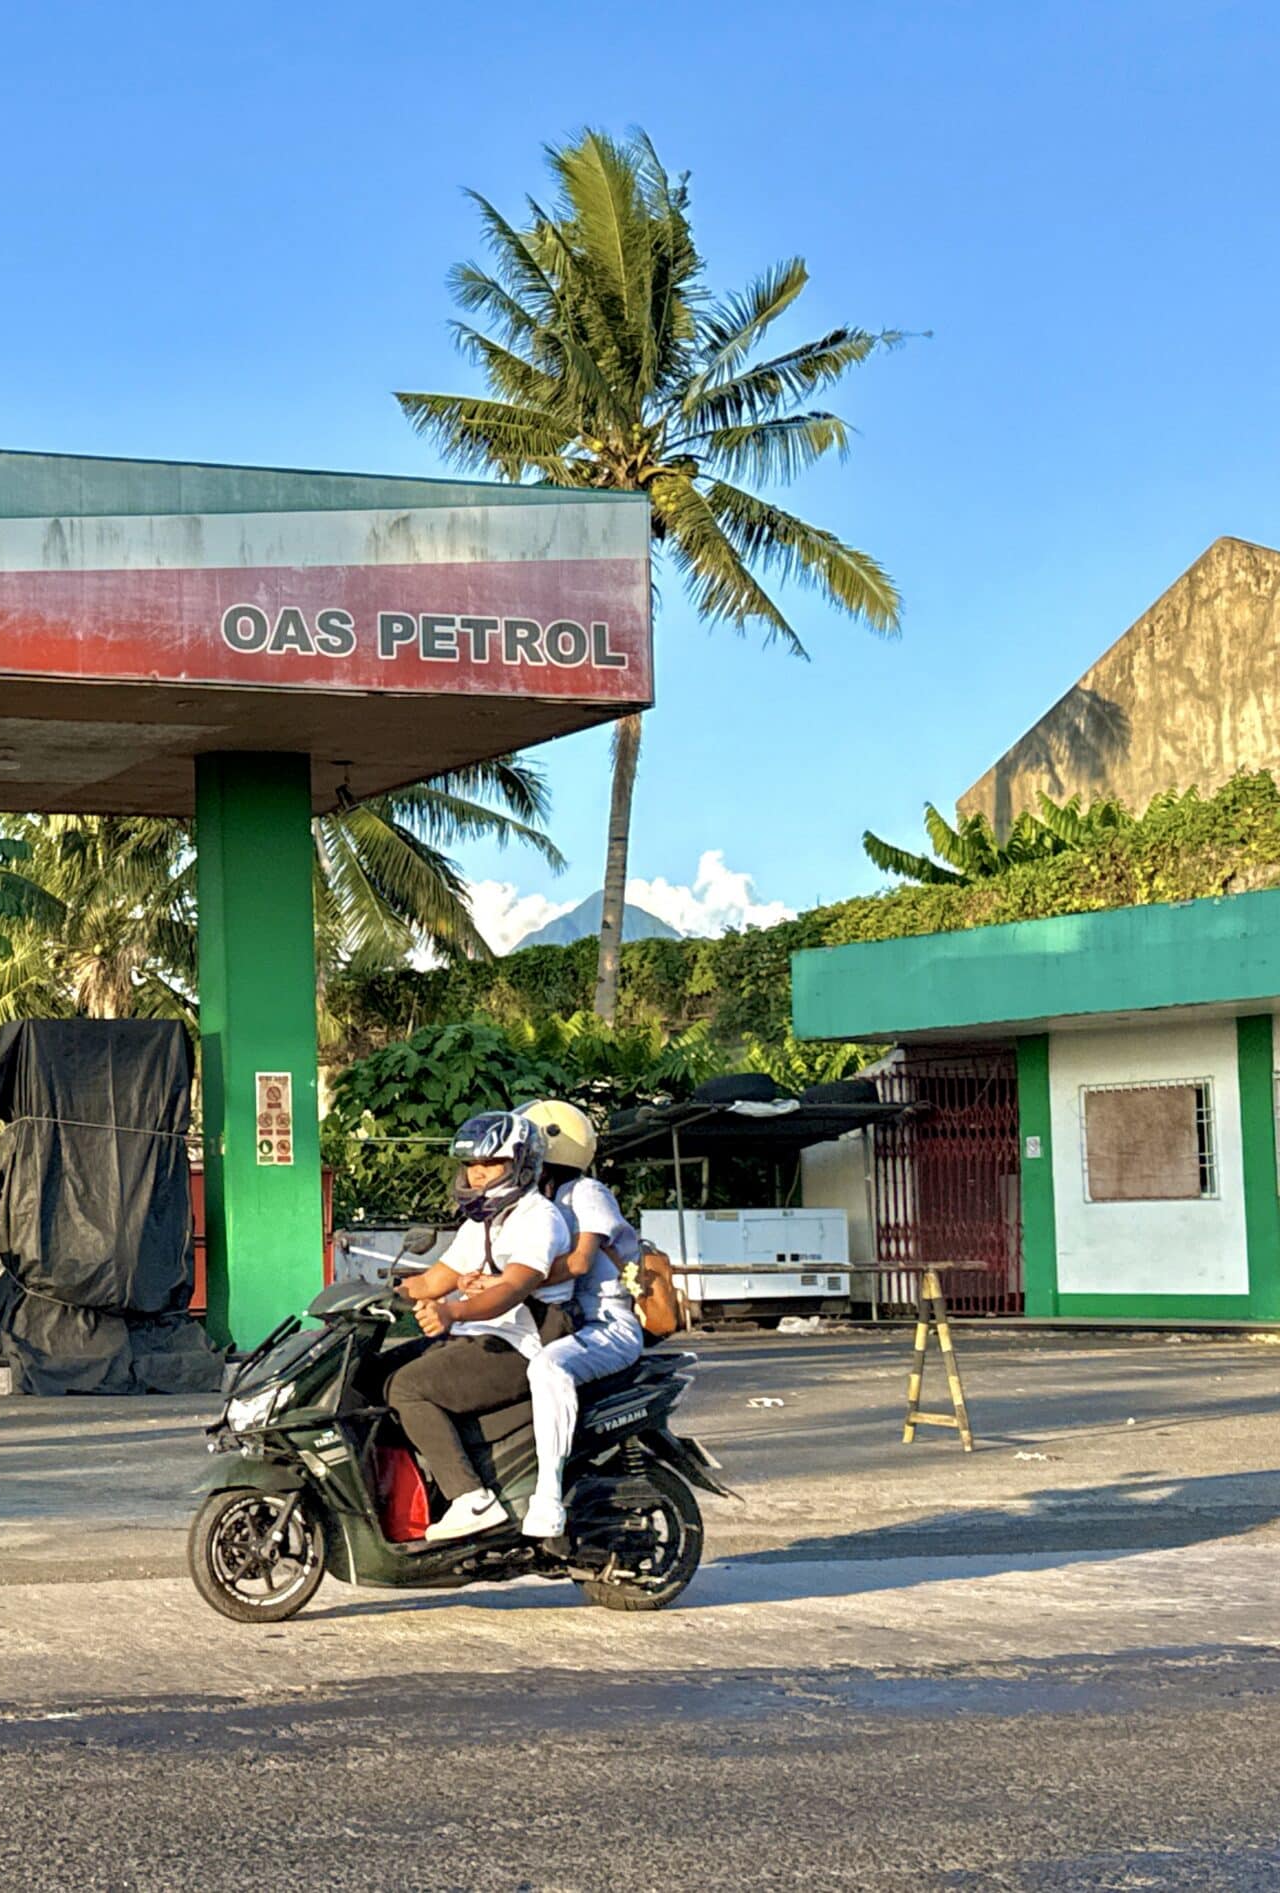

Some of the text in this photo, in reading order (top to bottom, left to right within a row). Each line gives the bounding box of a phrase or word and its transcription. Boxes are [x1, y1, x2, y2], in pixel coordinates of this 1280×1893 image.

[220, 602, 629, 670] OAS PETROL
[604, 1407, 648, 1431] YAMAHA
